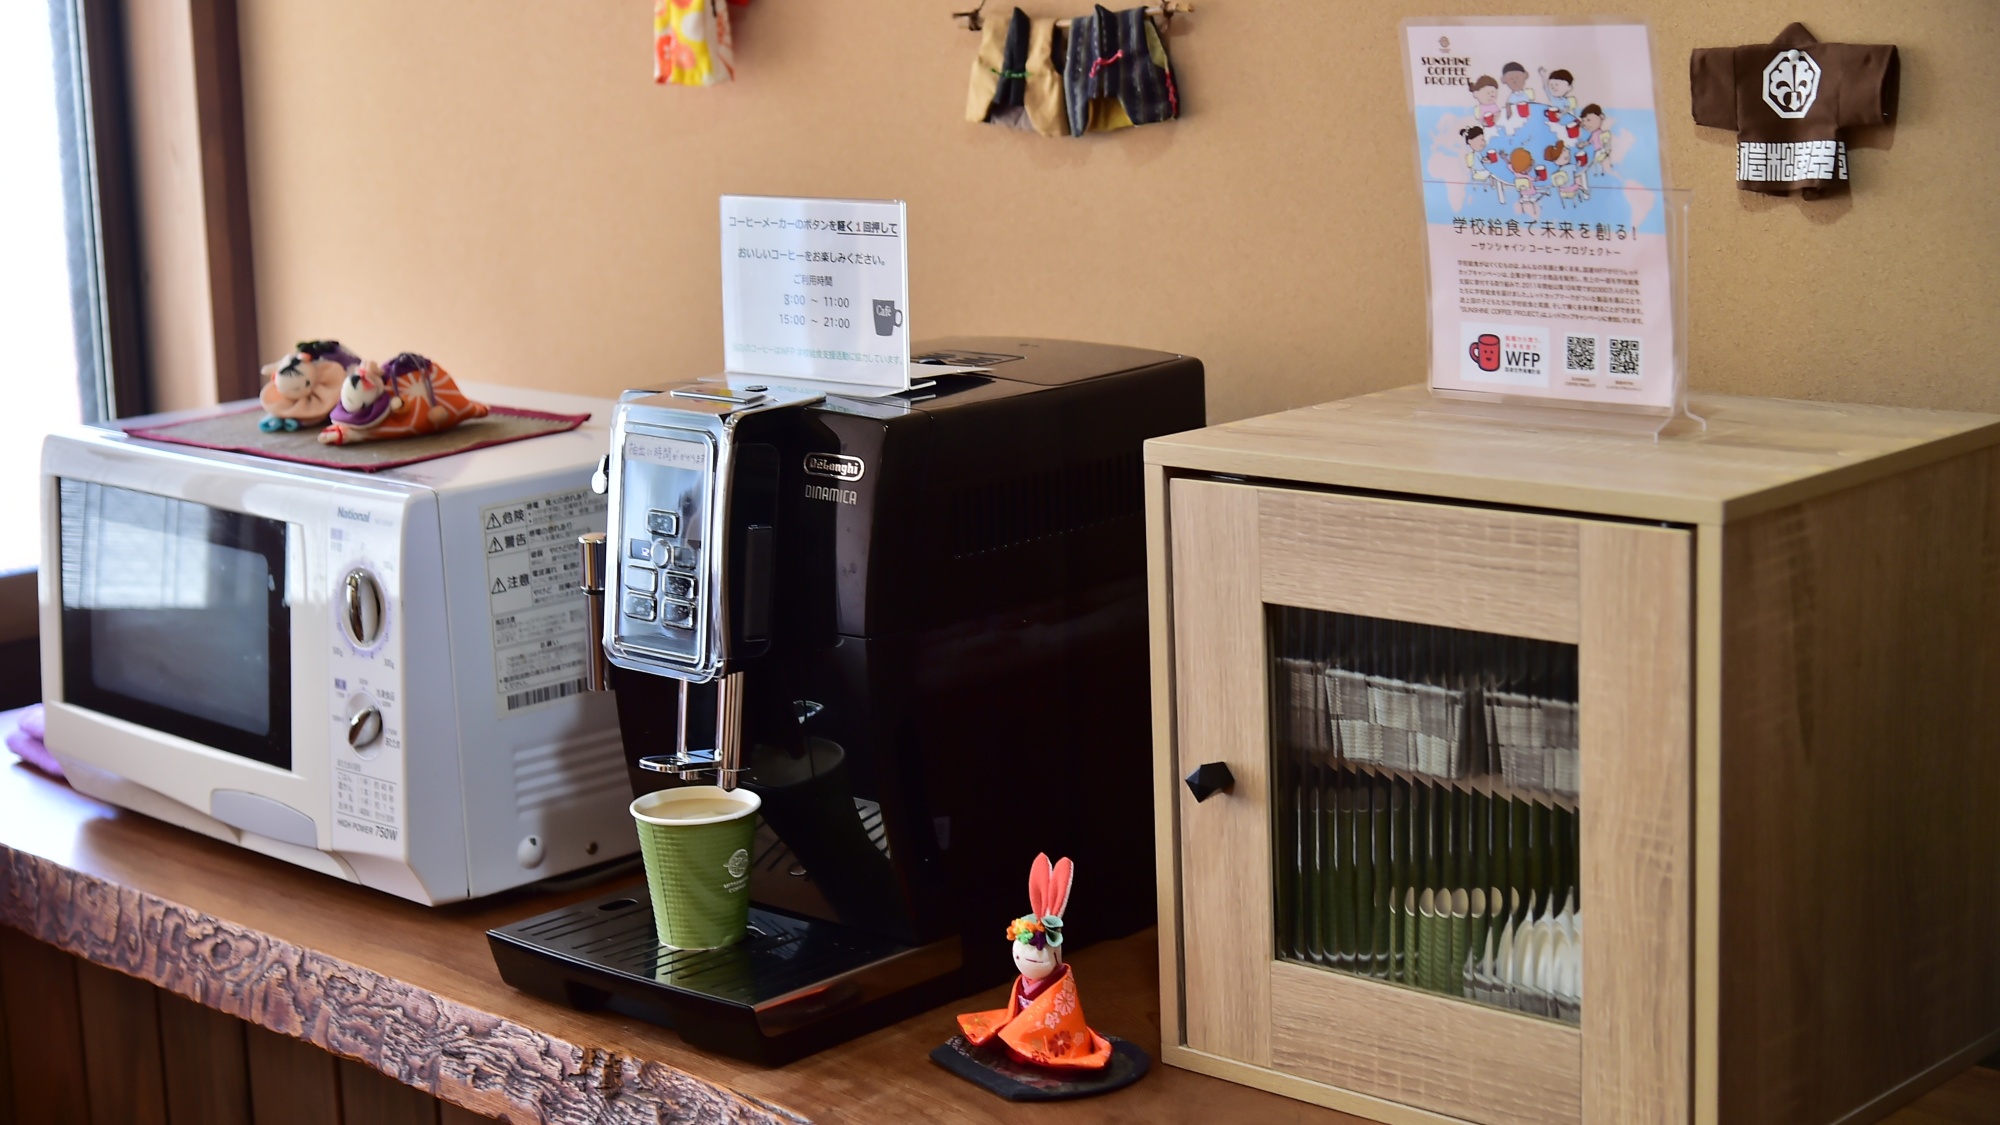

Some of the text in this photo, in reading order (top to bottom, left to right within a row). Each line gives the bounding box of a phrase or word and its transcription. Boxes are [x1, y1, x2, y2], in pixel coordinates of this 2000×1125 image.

[1421, 56, 1472, 67] SUNSHINE
[1427, 67, 1467, 76] COFFEE
[1424, 76, 1473, 86] PROJECT
[1452, 217, 1637, 242] 学校給食で未来を創る!
[738, 247, 887, 266] おいしいコーヒーをお楽しみください。
[1529, 244, 1561, 254] コーヒー
[793, 274, 833, 287] ご利用時間
[824, 296, 850, 309] 11:00
[779, 313, 806, 326] 15:00
[823, 316, 850, 329] 21:00
[1505, 350, 1541, 367] WFP
[805, 484, 857, 505] DINAMICA
[337, 506, 371, 523] National
[502, 509, 525, 525] 危険
[504, 533, 527, 548] 警告
[507, 573, 530, 590] 注意
[352, 821, 373, 835] POWER
[375, 825, 398, 841] 750W
